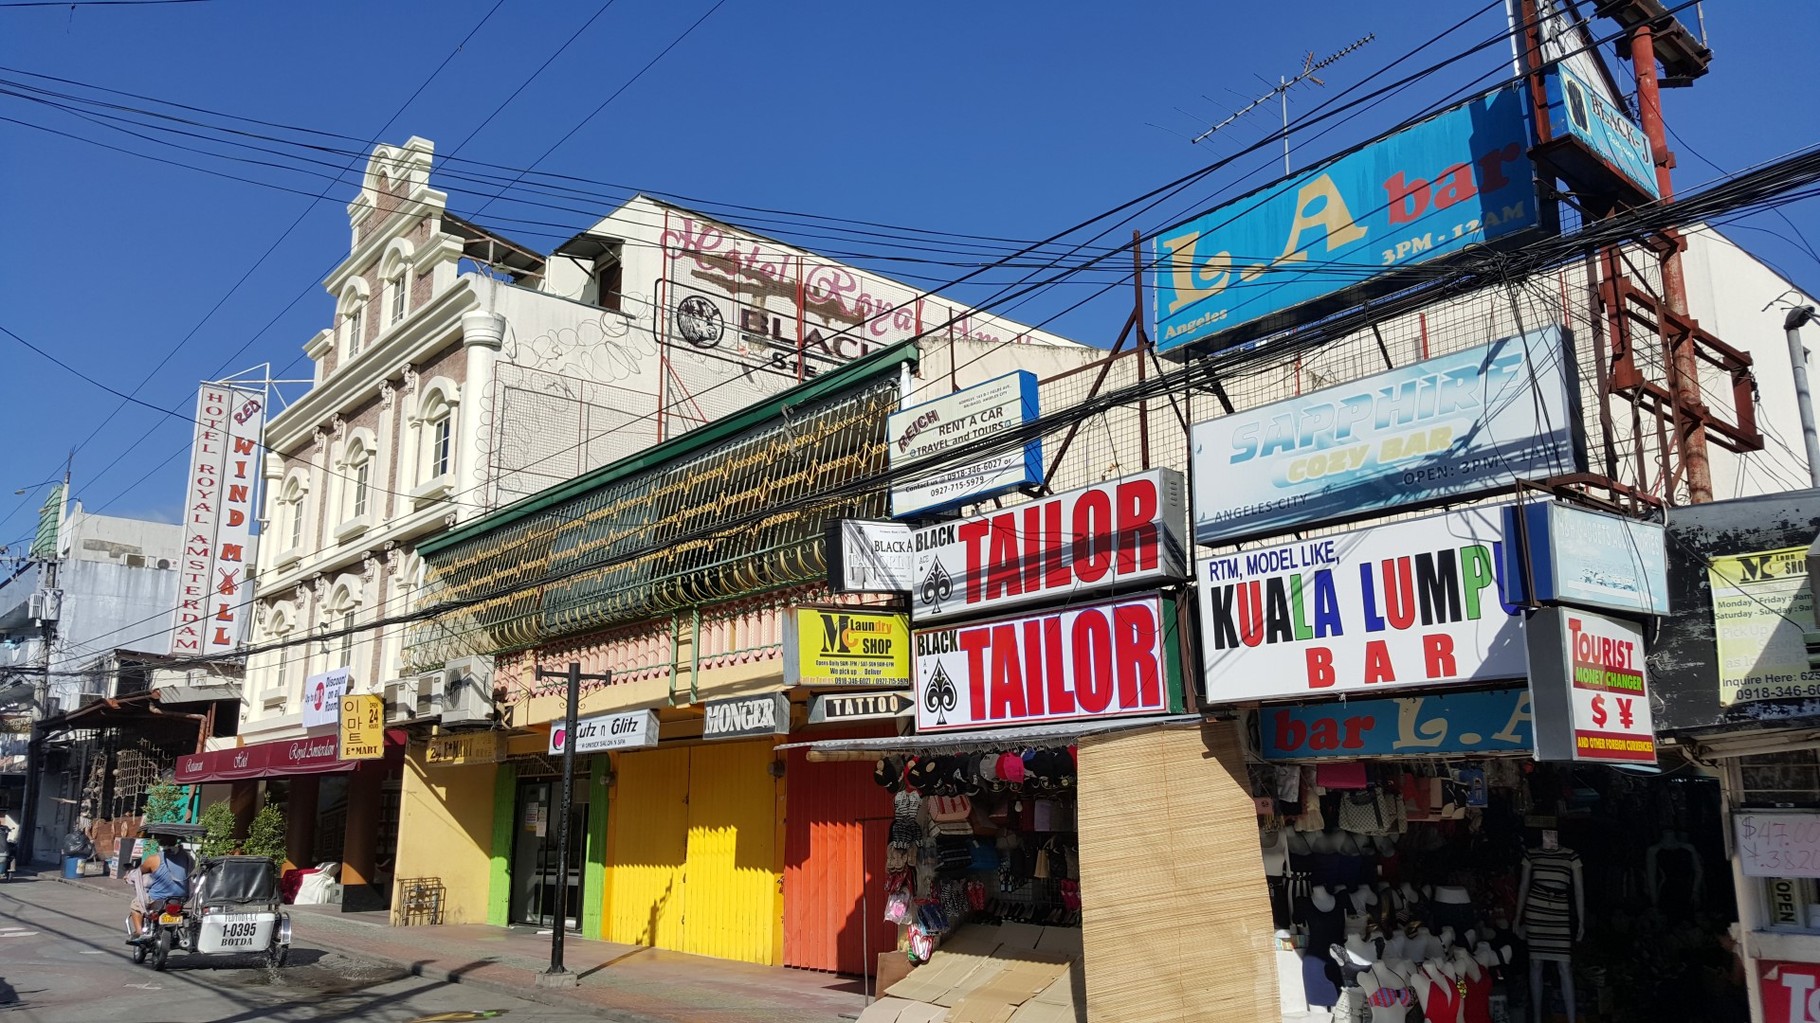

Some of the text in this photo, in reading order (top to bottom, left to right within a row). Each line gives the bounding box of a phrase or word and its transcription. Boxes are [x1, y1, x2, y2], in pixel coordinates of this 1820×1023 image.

[1382, 141, 1523, 226] bar
[1381, 235, 1435, 267] 3PM
[1450, 200, 1525, 240] 12AM
[660, 215, 788, 284] Hotel
[805, 263, 926, 337] Royal
[740, 308, 869, 361] BLAC
[1163, 308, 1229, 341] Angeles
[233, 399, 262, 426] RED
[938, 406, 1003, 437] RENT A CAR
[1229, 351, 1526, 465] SAPPHIRE
[898, 408, 941, 454] REICH
[916, 420, 1004, 457] TRAVEL and TOURS
[1287, 424, 1455, 484] COZY BAR
[1402, 465, 1455, 486] OPEN:
[1459, 454, 1499, 475] 3PM
[226, 436, 256, 527] WIND
[905, 480, 930, 493] Contact
[175, 392, 223, 650] HOTEL ROYAL AMSTERDAM
[1214, 495, 1308, 523] ANGELES CITY
[915, 477, 1159, 605] BLACK TAILOR
[1208, 540, 1341, 582] RTM, MODEL LIKE,
[1785, 560, 1809, 575] SHO
[1210, 568, 1344, 650] KUALA
[1715, 609, 1753, 621] Saturday
[1759, 605, 1793, 617] Sunday
[1718, 598, 1752, 610] Monday
[1760, 594, 1790, 606] Friday
[850, 619, 893, 635] Laundry
[1568, 617, 1634, 670] TOURIST
[862, 638, 892, 655] SHOP
[916, 602, 1162, 723] BLACK TAILOR
[1575, 666, 1605, 686] MONEY
[1605, 672, 1643, 691] CHANGER
[1722, 674, 1765, 688] Inquire
[1765, 672, 1798, 684] Here:
[344, 699, 363, 745] 이마트
[369, 708, 379, 724] 24
[704, 697, 776, 735] MONGER
[833, 695, 899, 716] TATTOO
[1591, 693, 1634, 729] $ ¥
[611, 716, 639, 736] Glitz
[1273, 709, 1375, 752] bar
[1577, 736, 1589, 748] AND
[1776, 881, 1796, 923] OPEN
[222, 922, 257, 938] 1-0395
